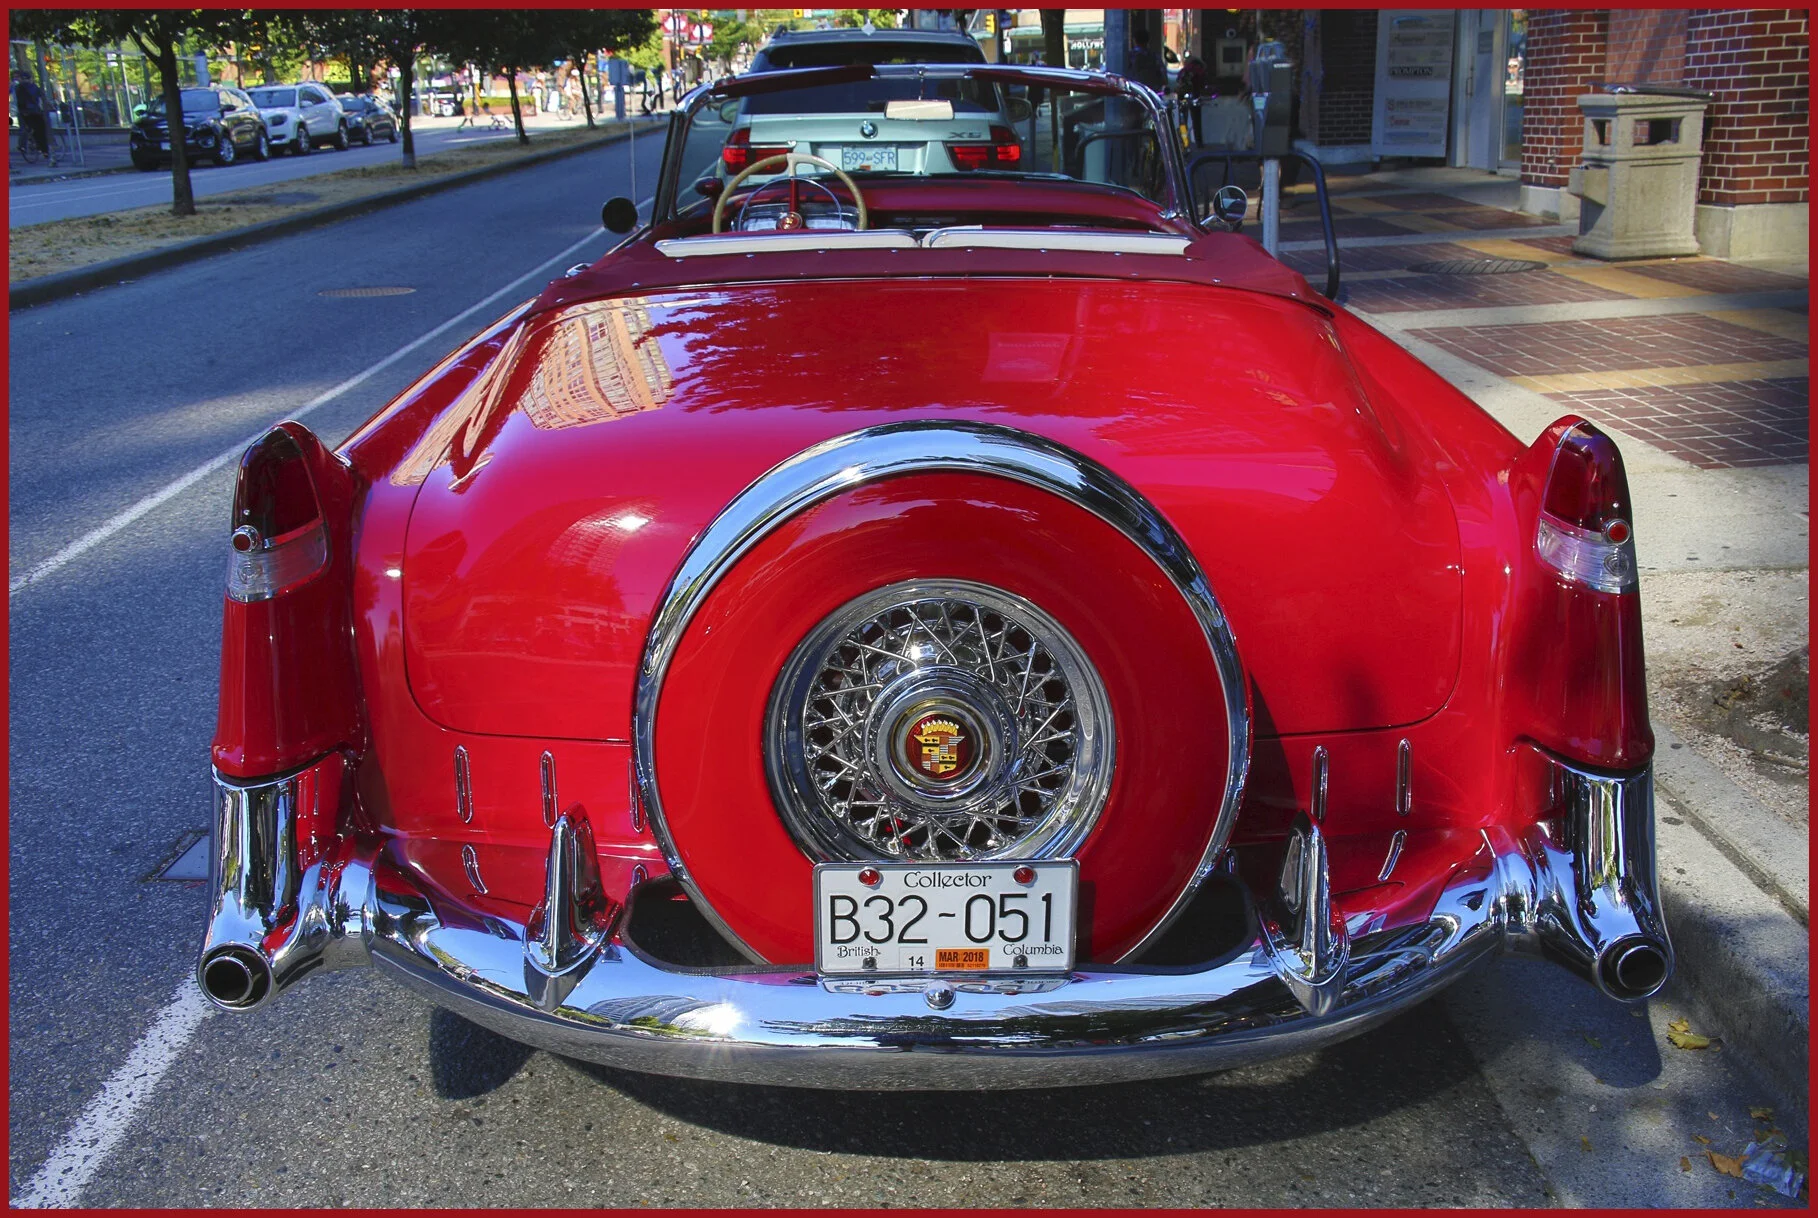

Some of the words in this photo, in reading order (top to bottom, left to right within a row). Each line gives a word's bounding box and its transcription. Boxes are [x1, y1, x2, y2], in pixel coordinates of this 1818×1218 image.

[903, 871, 992, 889] Collector
[829, 892, 1053, 945] B32-051
[837, 945, 881, 959] British
[1002, 943, 1064, 956] Columbia
[908, 955, 925, 967] 14
[938, 951, 959, 962] MAR
[962, 951, 984, 962] 2018
